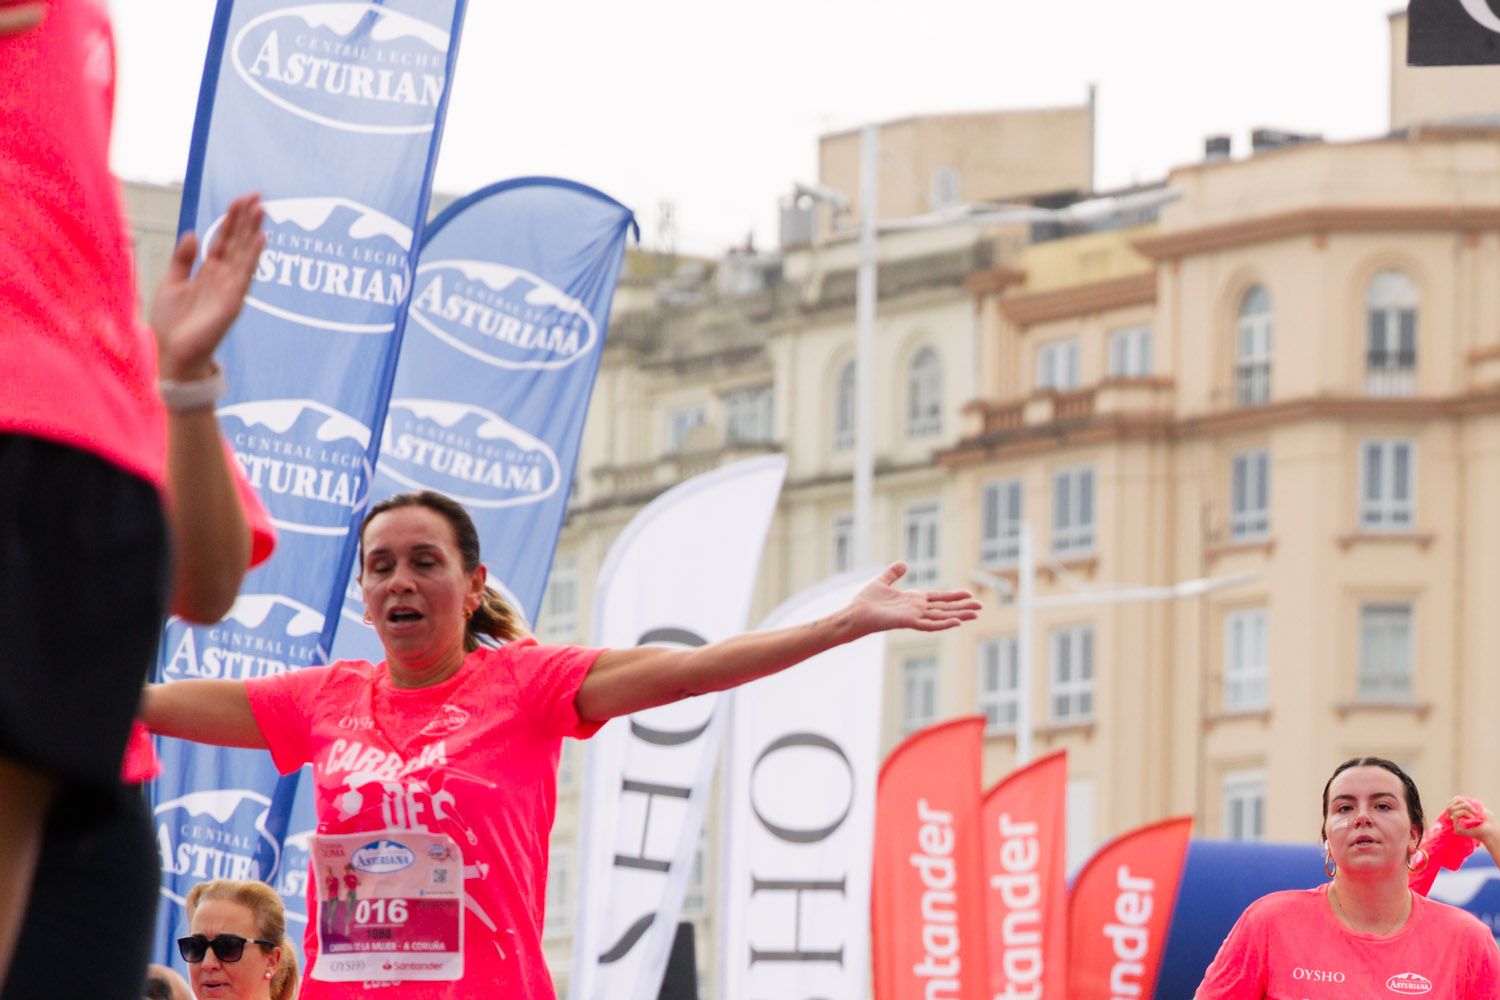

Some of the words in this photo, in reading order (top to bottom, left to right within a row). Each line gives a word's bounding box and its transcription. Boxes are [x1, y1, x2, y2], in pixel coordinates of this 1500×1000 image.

[295, 33, 368, 60] CENTRAL
[265, 230, 346, 258] CENTRAL
[253, 249, 406, 307] STURIAN
[414, 273, 580, 356] ASTURIANA
[235, 432, 313, 460] CENTRAL
[208, 628, 283, 655] CENTRAL
[181, 824, 250, 850] CENTRAL
[354, 899, 409, 924] 016
[393, 960, 443, 971] Santander
[1293, 967, 1345, 983] OYSHO
[1390, 978, 1430, 991] ASTURIANA
